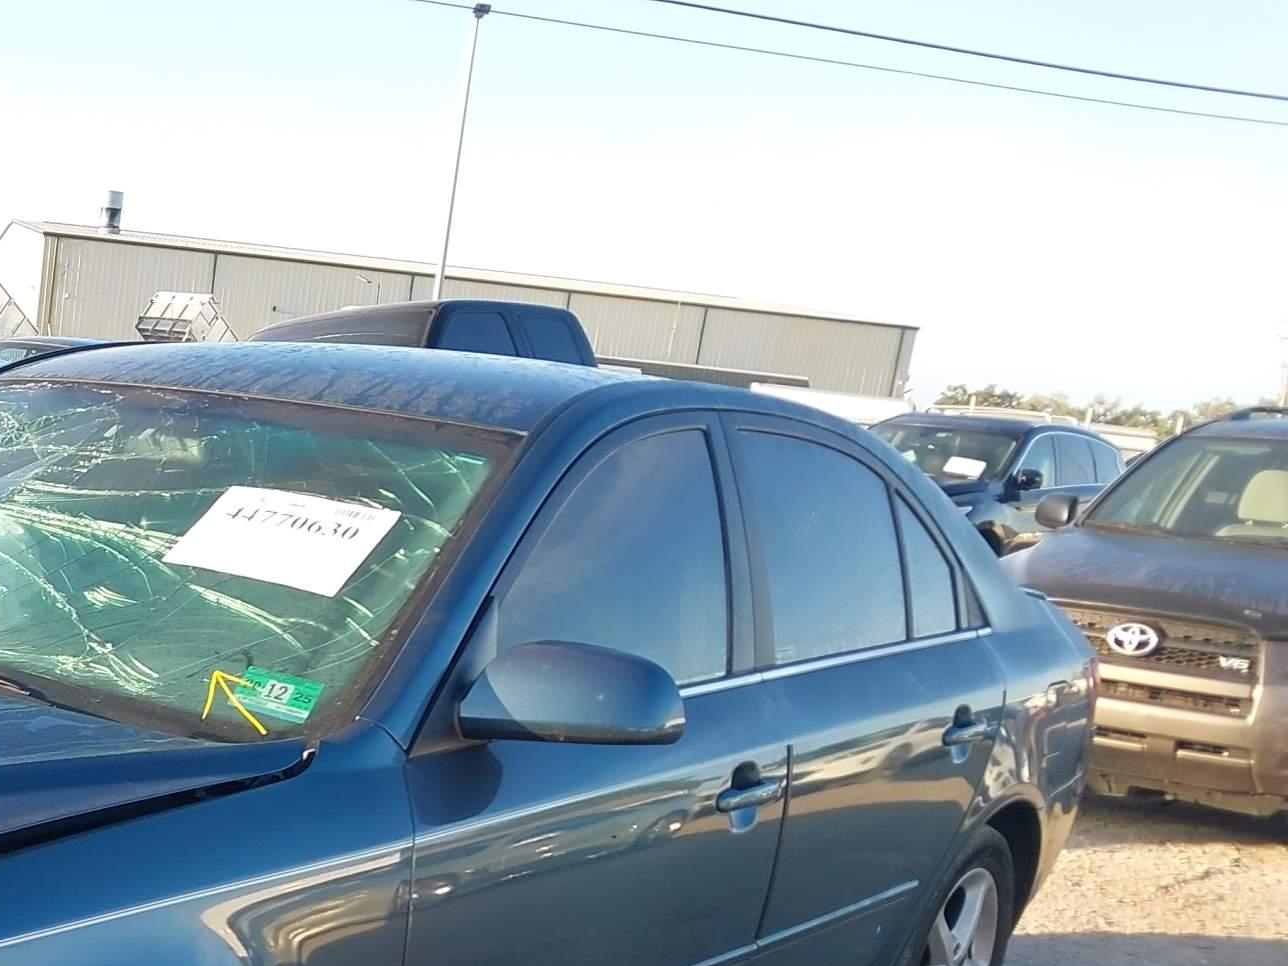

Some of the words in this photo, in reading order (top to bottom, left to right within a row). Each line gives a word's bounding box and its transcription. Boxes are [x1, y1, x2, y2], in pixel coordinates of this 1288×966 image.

[225, 506, 361, 541] 44770630
[1219, 655, 1251, 673] V6
[264, 682, 289, 702] 12
[293, 692, 313, 705] 25
